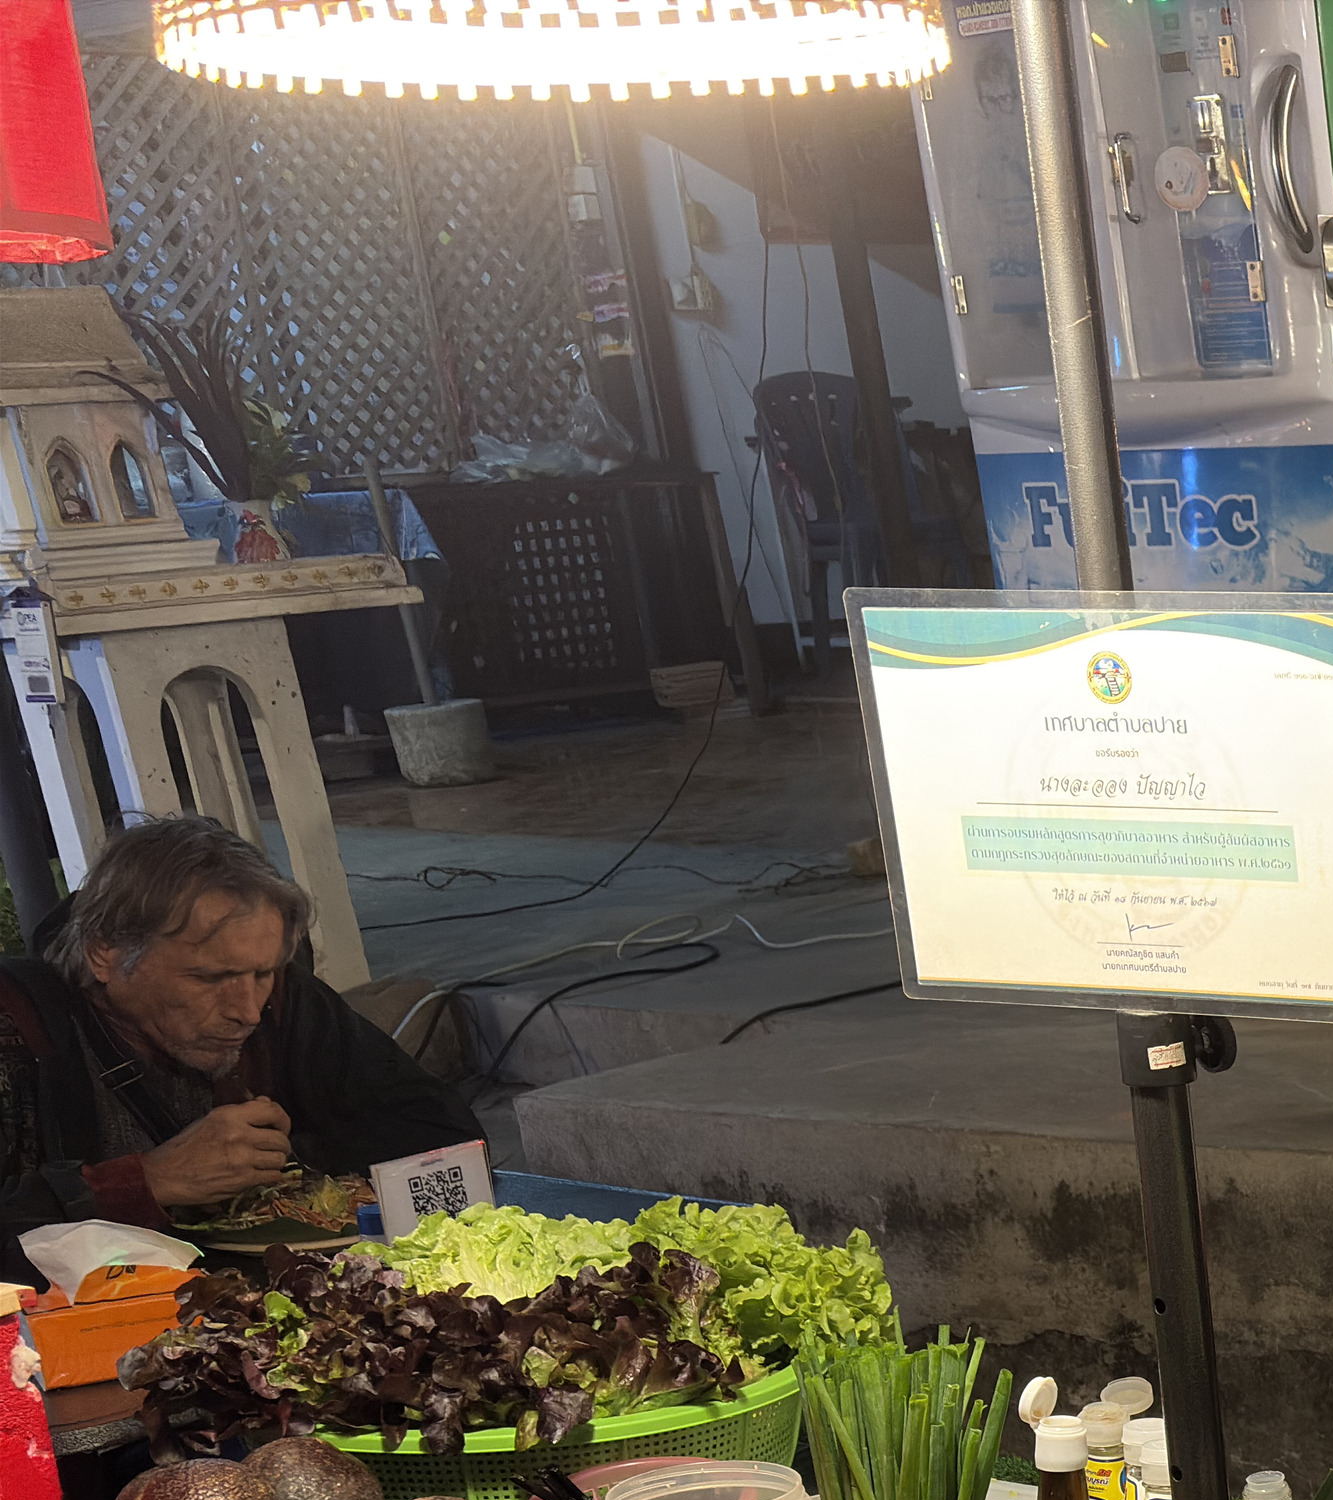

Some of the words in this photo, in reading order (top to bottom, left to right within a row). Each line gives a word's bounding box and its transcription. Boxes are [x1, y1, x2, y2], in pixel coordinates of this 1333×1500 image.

[1043, 711, 1187, 736] เทศบาลตำบลปาย
